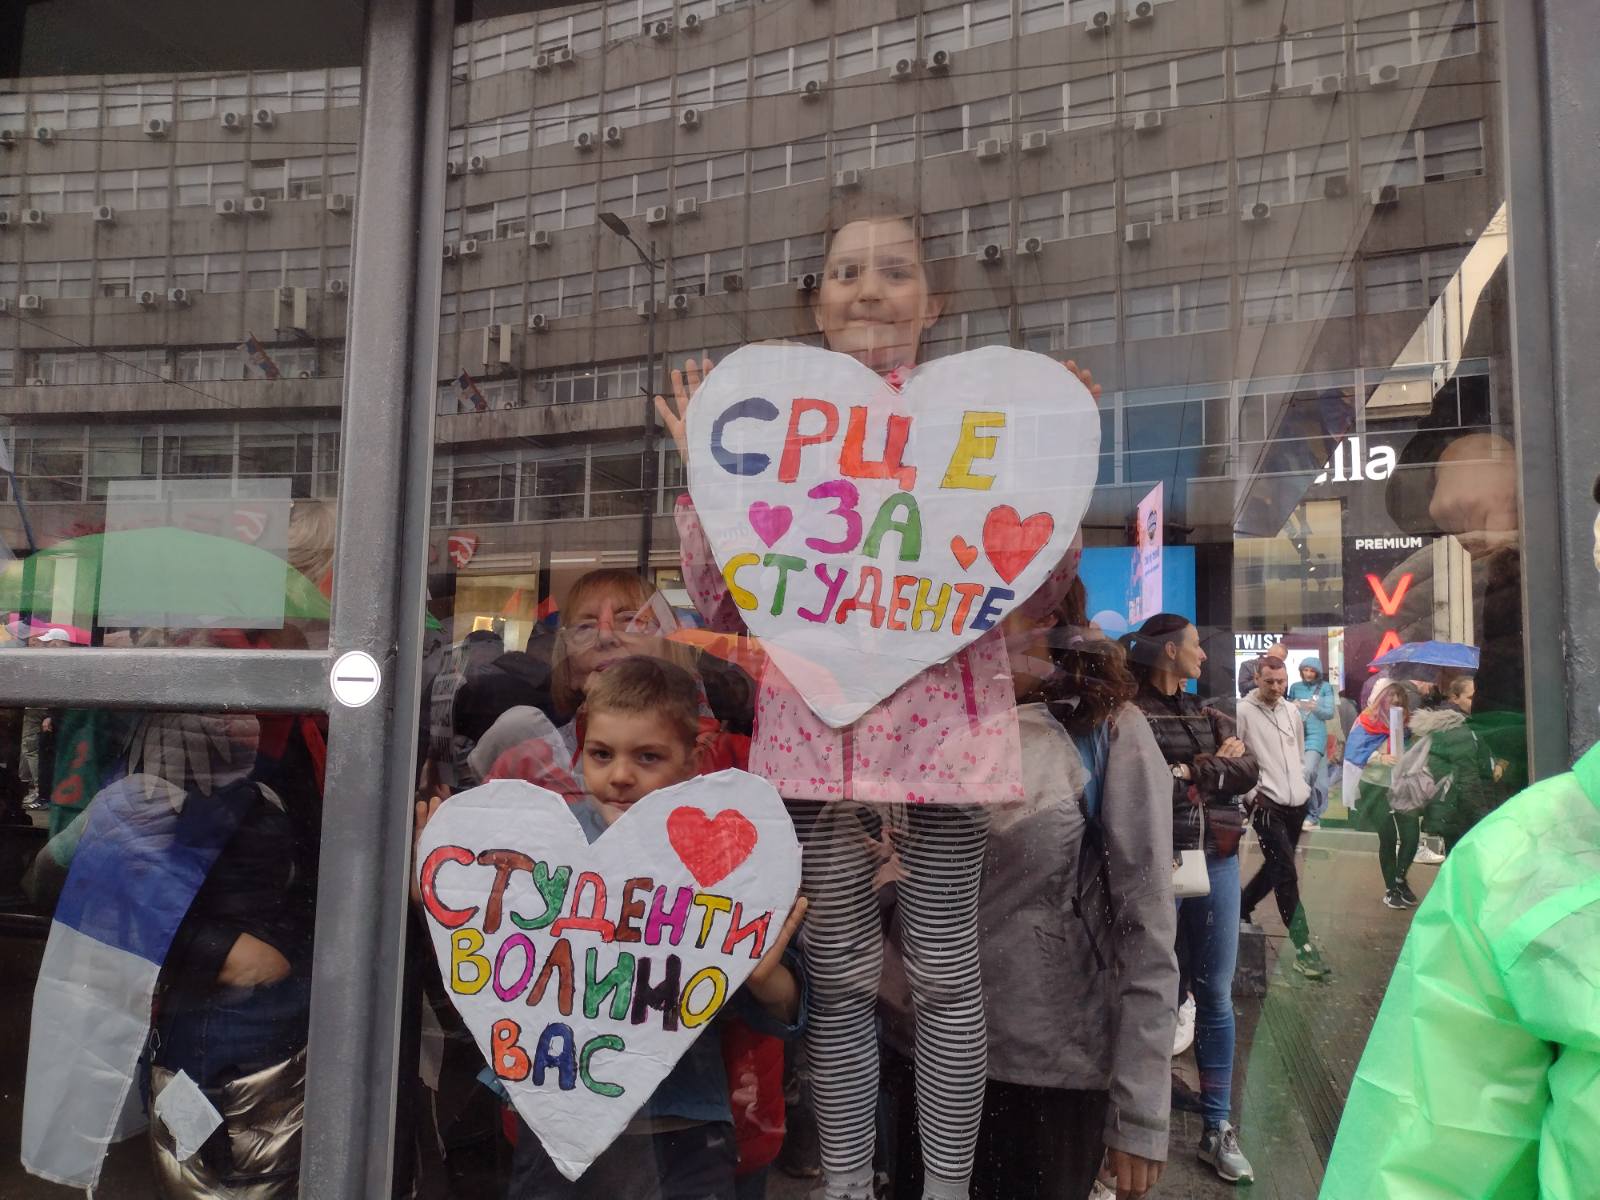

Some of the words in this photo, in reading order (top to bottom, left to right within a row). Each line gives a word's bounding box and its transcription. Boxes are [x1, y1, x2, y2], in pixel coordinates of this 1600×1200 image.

[710, 397, 1007, 491] СРЦЕ
[805, 479, 923, 562] ЗА
[1355, 537, 1422, 550] PREMIUM
[722, 552, 1015, 635] СТУДЕНТЕ
[1235, 634, 1283, 649] TWIST
[420, 845, 775, 959] СТУДЕНТИ
[450, 928, 728, 1031] ВОЛИМО
[491, 1019, 625, 1097] ВАС
